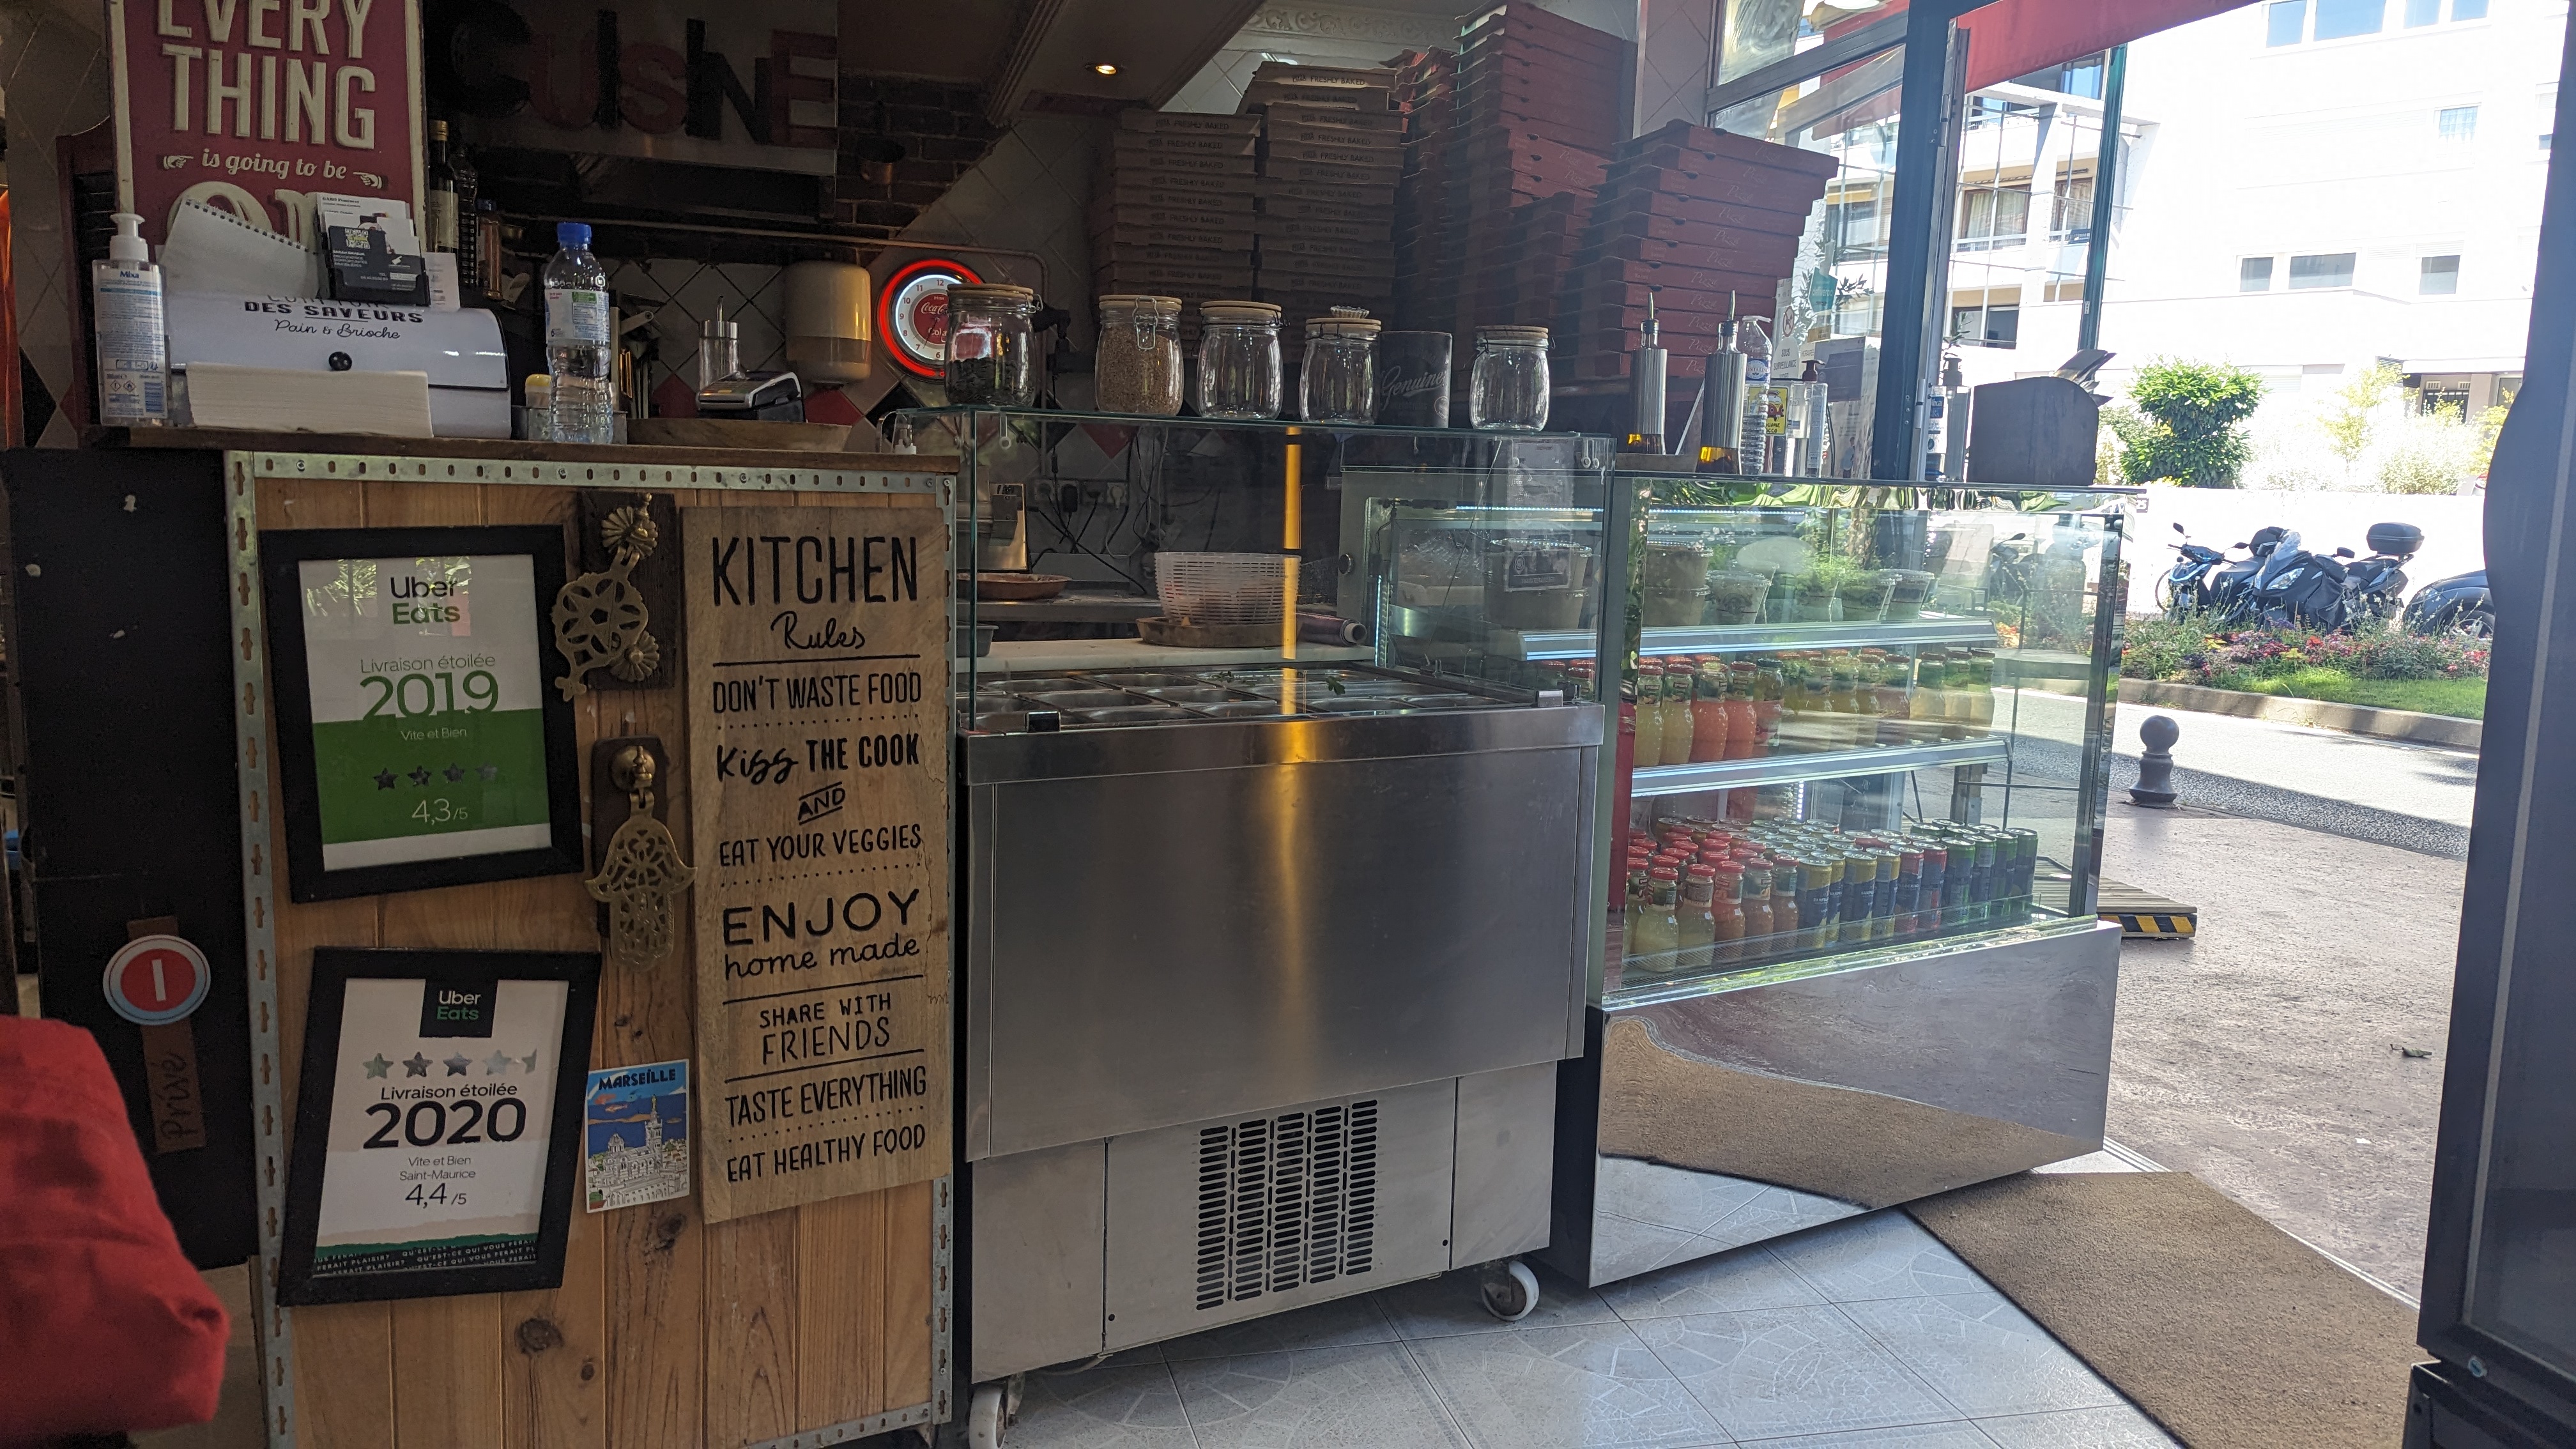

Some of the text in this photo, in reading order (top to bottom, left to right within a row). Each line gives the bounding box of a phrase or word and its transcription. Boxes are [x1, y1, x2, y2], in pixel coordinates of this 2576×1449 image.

[162, 43, 376, 150] THING
[1341, 77, 1365, 86] BAKED
[202, 148, 348, 180] is going to be
[119, 270, 139, 279] Mixa
[1690, 271, 1719, 288] Pizza
[244, 301, 292, 314] DES
[303, 305, 424, 323] SAVEURS
[274, 319, 318, 334] Pain
[336, 323, 401, 339] Brioche
[1381, 365, 1445, 410] Genuine
[390, 576, 458, 599] Uber
[712, 537, 918, 606] KITCHEN
[392, 602, 461, 625] Eats
[770, 610, 866, 650] Rules
[361, 652, 496, 674] Livraison étoilée
[359, 670, 500, 721] 2019
[712, 672, 922, 714] DON'T WASTE FOOD
[400, 727, 468, 742] Vite et Bien
[717, 733, 920, 785] Kiss THE COOK
[797, 787, 847, 821] AND
[719, 823, 921, 867] EAT YOUR VEGGIES
[723, 888, 920, 946] ENJOY
[725, 932, 920, 981] home made
[436, 1006, 480, 1021] Eats
[438, 990, 481, 1006] Uber
[760, 992, 891, 1029] SHARE WITH
[762, 1016, 891, 1065] FRIENDS
[380, 1083, 518, 1101] Livraison étoilée
[598, 1068, 676, 1091] MARSEILLE
[725, 1065, 926, 1127] TASTE EVERYTHING
[362, 1097, 526, 1150] 2020
[408, 1155, 471, 1167] Vite et Bien
[727, 1123, 926, 1183] EAT HEALTHY FOOD
[399, 1169, 477, 1182] Saint-Maurice
